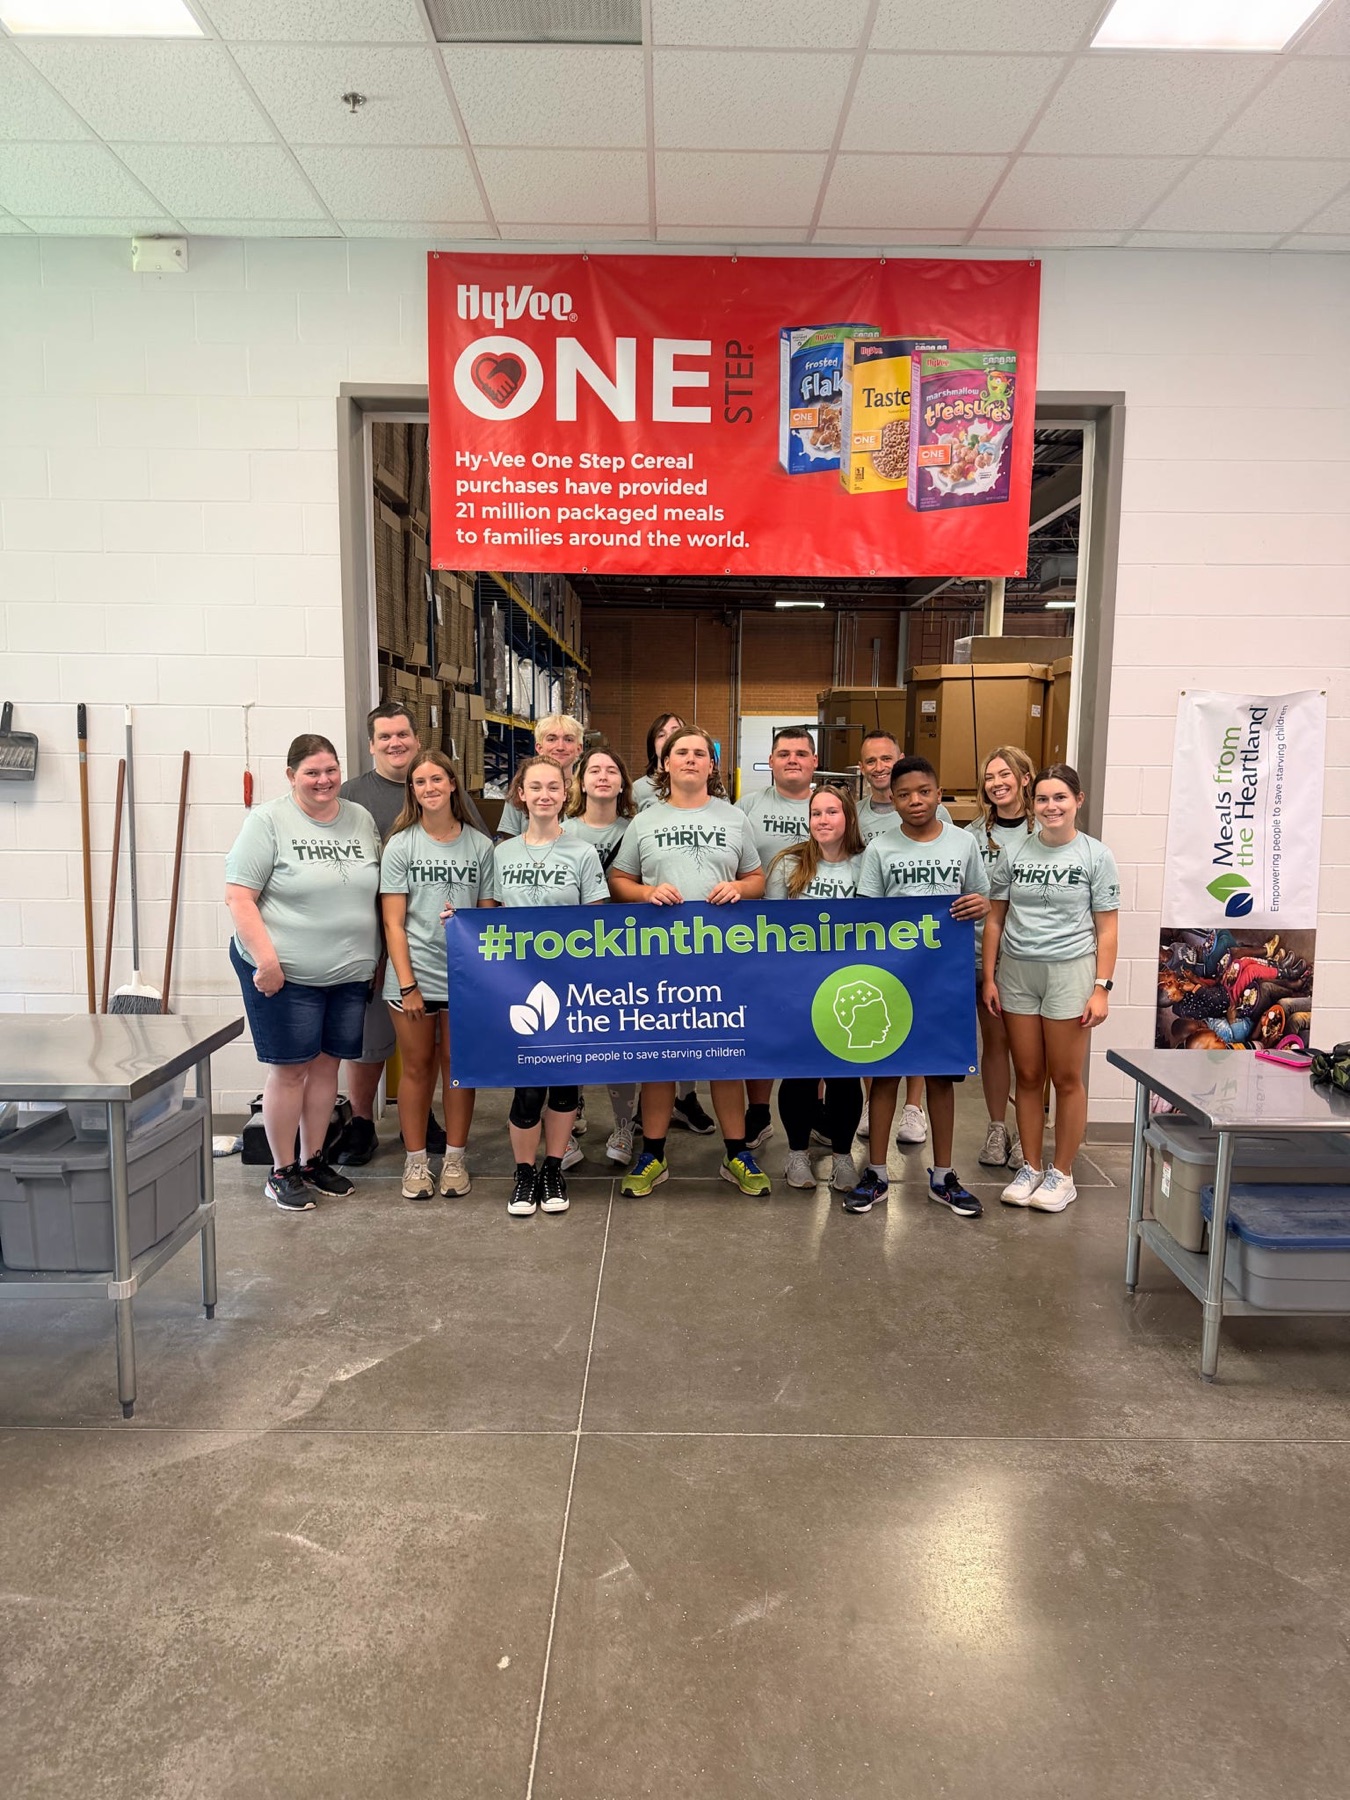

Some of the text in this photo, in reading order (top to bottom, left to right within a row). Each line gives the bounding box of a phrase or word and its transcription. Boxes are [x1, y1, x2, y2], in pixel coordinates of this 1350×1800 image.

[805, 357, 838, 370] frosted
[454, 335, 712, 424] ONE
[926, 387, 979, 401] marshmallow
[793, 413, 813, 421] ONE
[924, 400, 1011, 426] treasures
[853, 435, 876, 444] ONE
[455, 451, 694, 473] Hy-Vee One Step Cereal
[921, 450, 945, 459] ONE
[455, 477, 708, 499] purchases have provided
[455, 502, 724, 524] 21 million packaged meals
[456, 528, 750, 548] to families around the world.
[1234, 706, 1269, 867] the Heartland
[1212, 726, 1242, 867] Meals from
[1270, 704, 1289, 912] Empowering people to save starving children
[763, 814, 806, 822] ROOTED
[654, 824, 703, 834] ROOTED
[655, 831, 727, 848] THRIVE
[293, 845, 365, 861] THRIVE
[890, 859, 941, 869] ROOTED
[410, 866, 477, 883] THRIVE
[502, 869, 567, 886] THRIVE
[891, 866, 961, 884] THRIVE
[1012, 868, 1082, 886] THRIVE
[478, 911, 942, 961] #rockinthehairnet
[566, 980, 722, 1007] Meals from
[566, 1005, 746, 1034] the Heartland
[517, 1047, 746, 1066] Empowering people to save starving children
